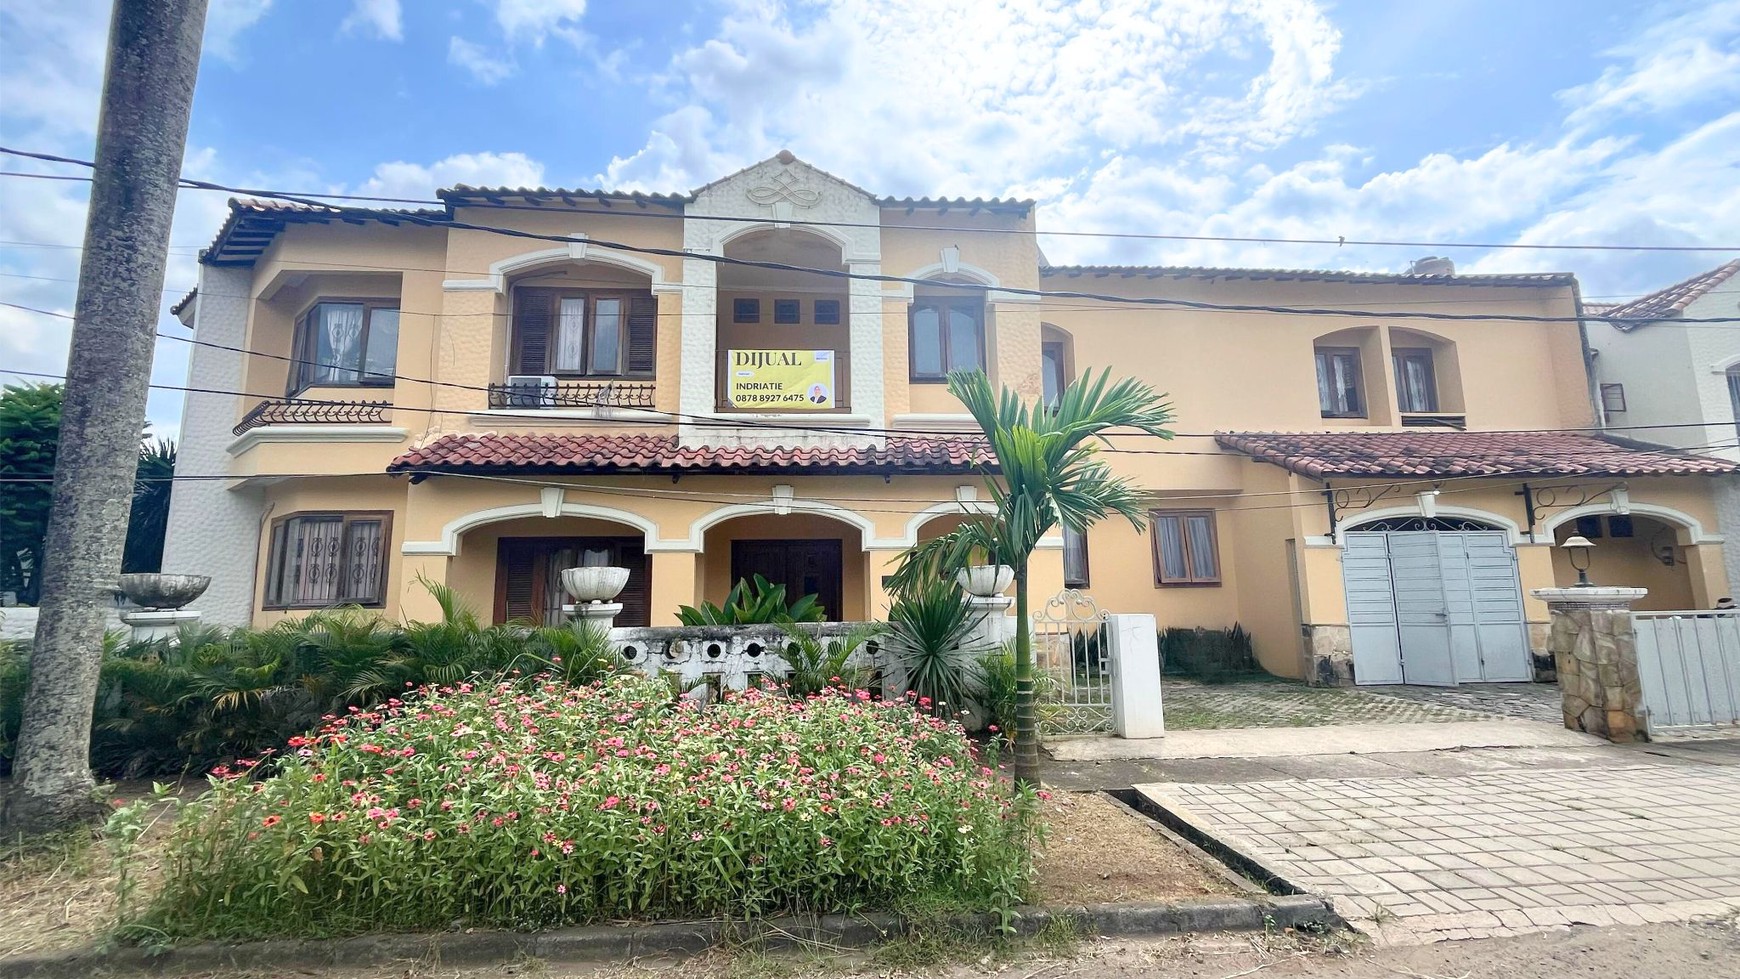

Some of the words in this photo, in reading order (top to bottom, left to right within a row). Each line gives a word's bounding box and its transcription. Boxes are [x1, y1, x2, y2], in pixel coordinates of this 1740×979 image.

[736, 352, 802, 369] DIJUAL
[736, 382, 783, 390] INDRIATIE
[735, 394, 758, 402] 0878
[759, 394, 781, 402] 8927
[782, 394, 805, 402] 6475
